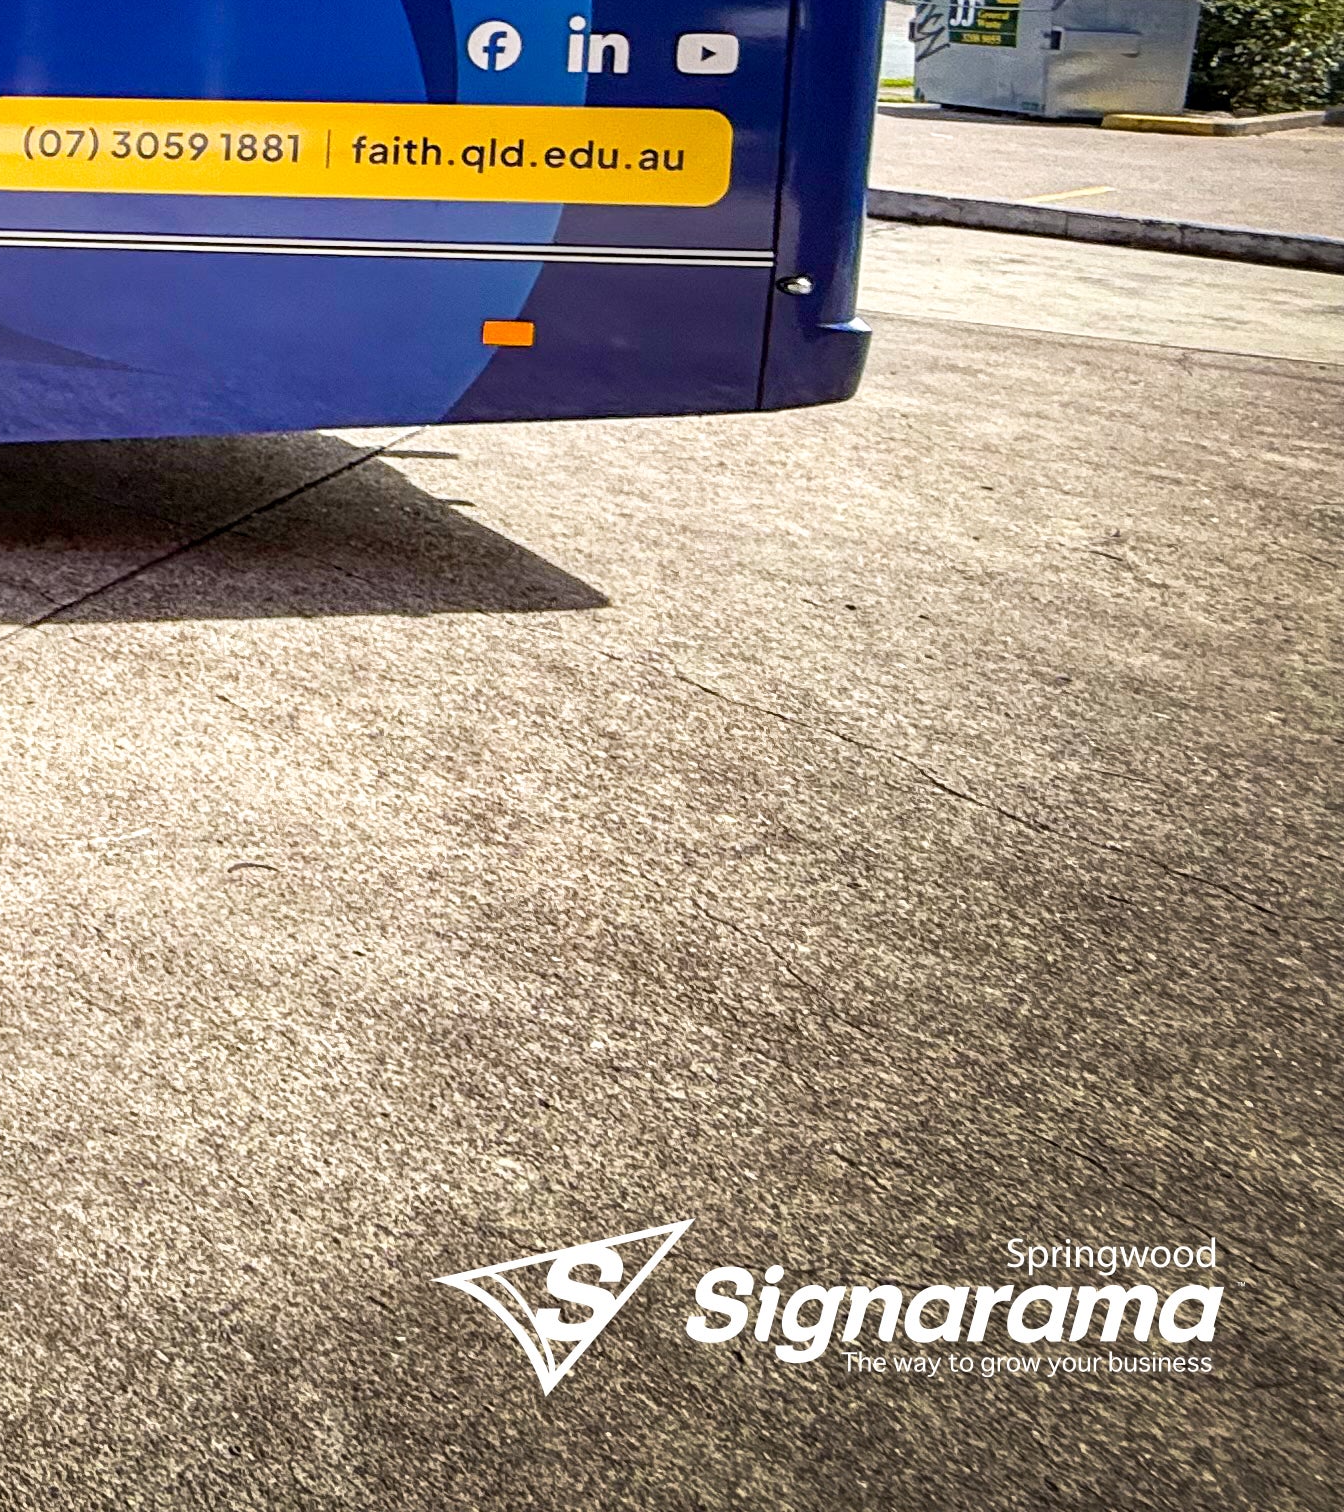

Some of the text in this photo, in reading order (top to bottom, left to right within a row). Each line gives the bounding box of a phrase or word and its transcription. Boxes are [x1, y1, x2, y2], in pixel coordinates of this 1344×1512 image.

[23, 126, 685, 174] (07) 3059 1881 faith.qld.edu.au
